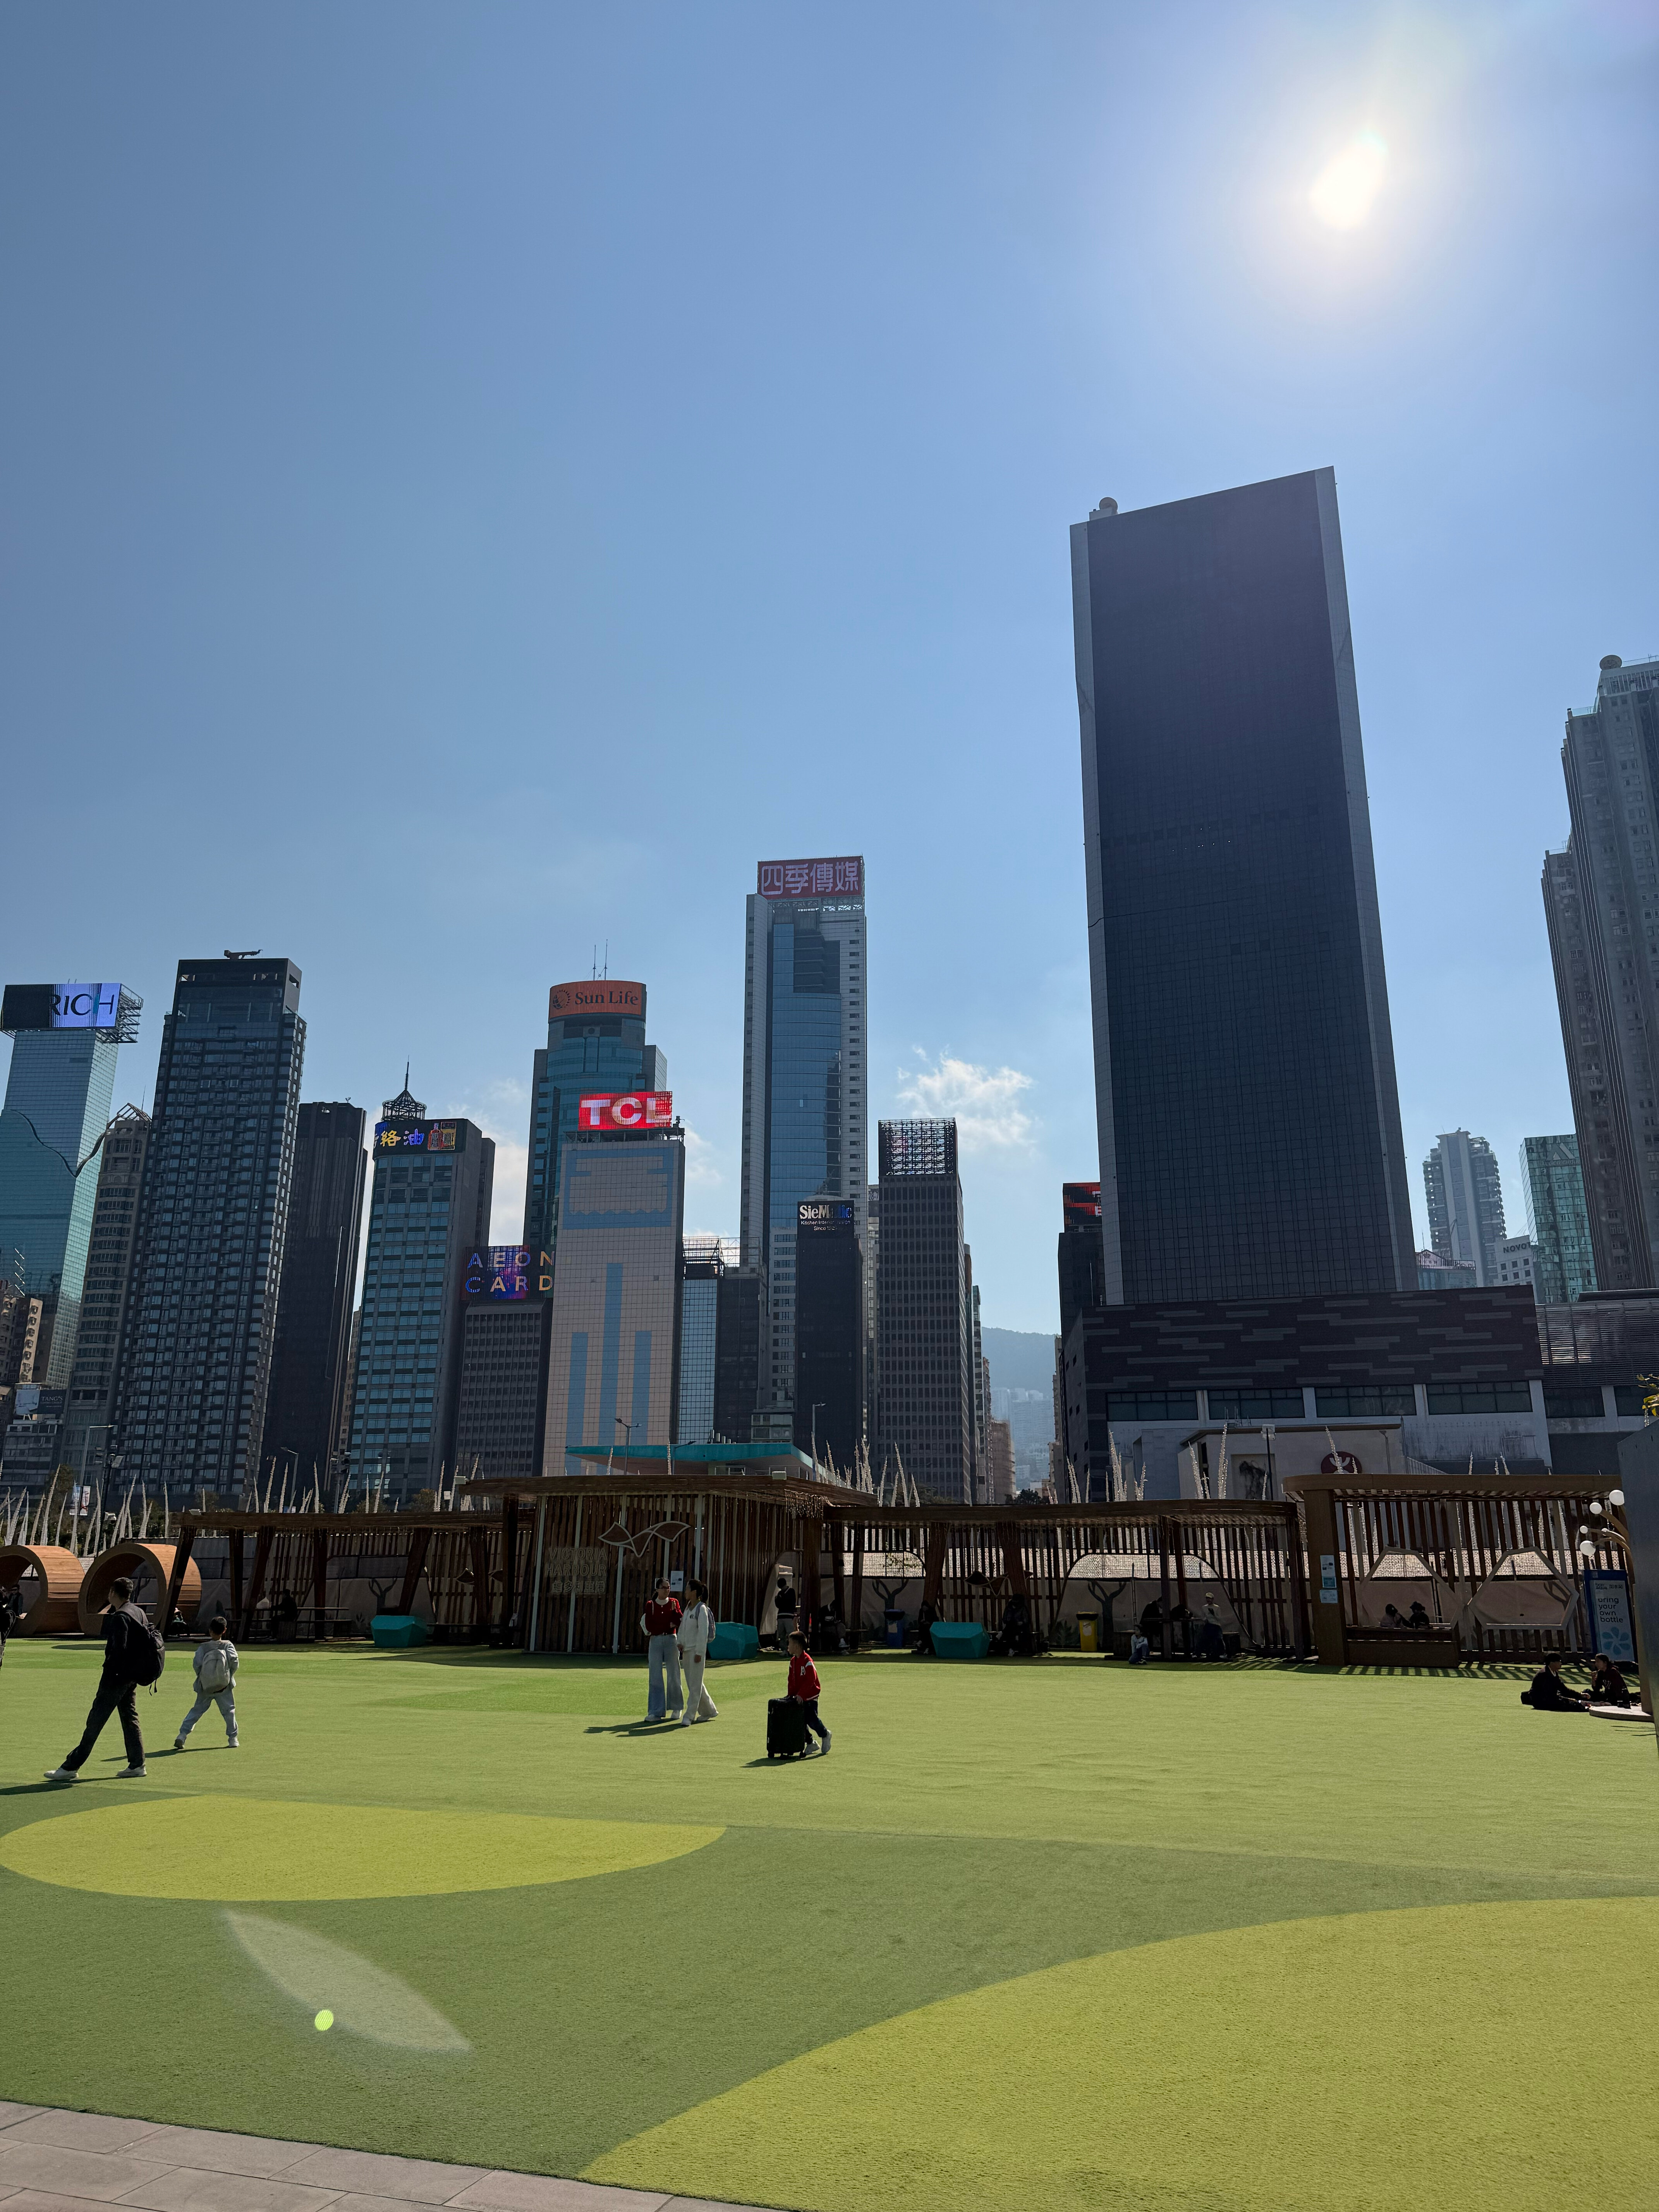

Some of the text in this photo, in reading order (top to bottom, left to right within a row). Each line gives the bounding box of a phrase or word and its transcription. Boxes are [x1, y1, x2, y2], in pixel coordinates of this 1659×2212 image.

[761, 861, 858, 895] 四季傳媒
[50, 993, 114, 1015] RICH
[575, 991, 638, 1005] Sun Life
[581, 1097, 670, 1125] TCL
[467, 1251, 555, 1269] AEON
[465, 1275, 554, 1293] CARD
[548, 1547, 608, 1560] VICTORIA
[545, 1563, 607, 1576] HARBOUR
